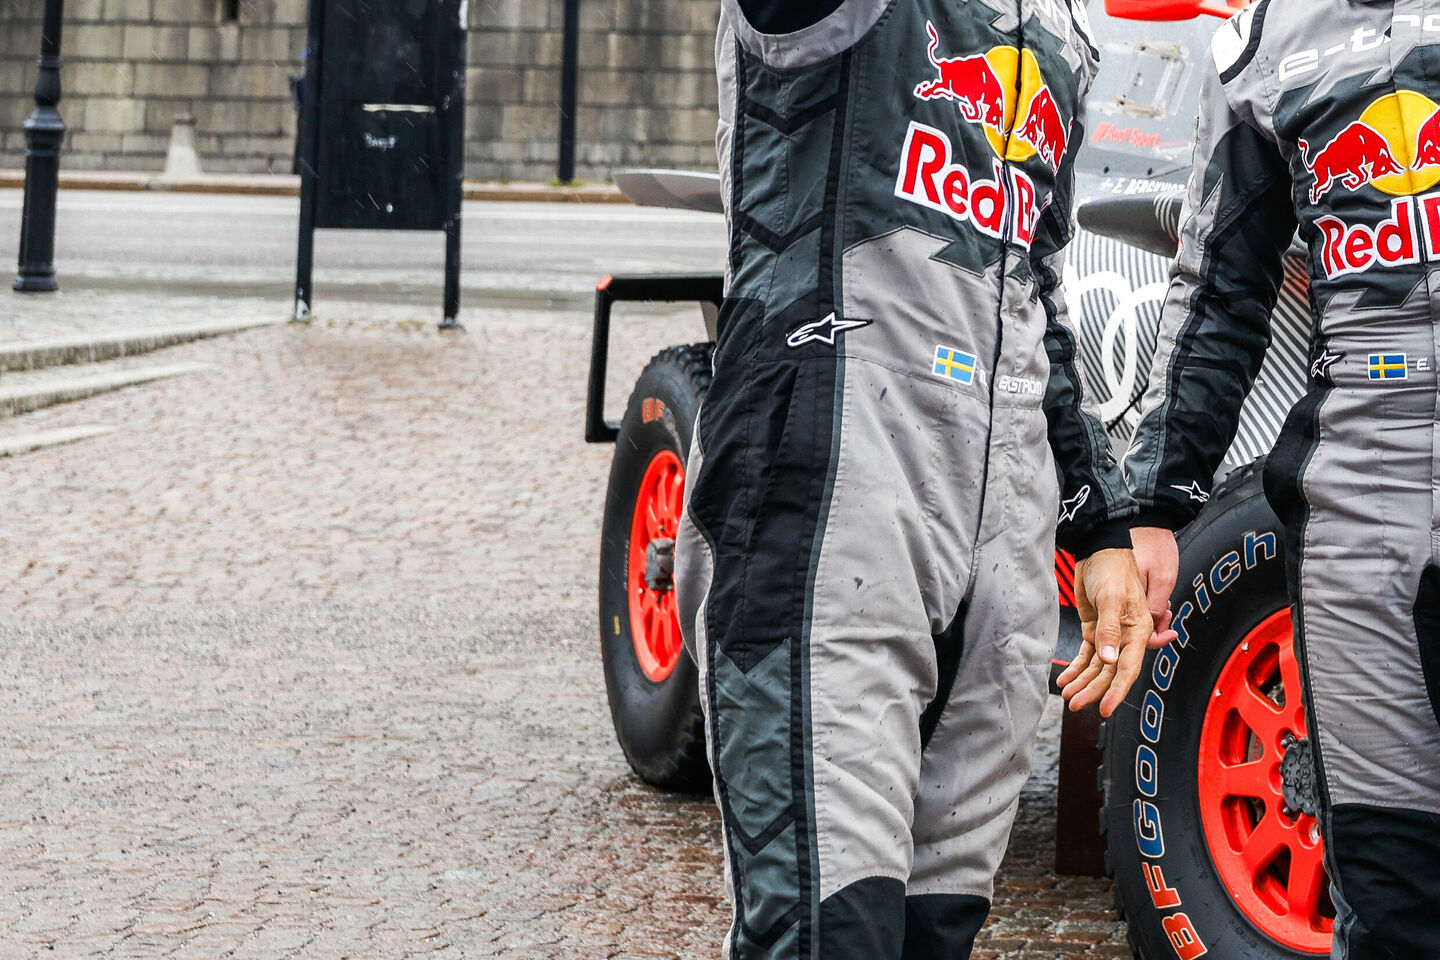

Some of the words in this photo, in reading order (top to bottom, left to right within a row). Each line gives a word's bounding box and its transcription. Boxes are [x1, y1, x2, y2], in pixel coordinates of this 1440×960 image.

[1106, 125, 1131, 142] Audi
[1129, 127, 1161, 147] Sport
[898, 123, 1005, 237] Red
[1315, 197, 1418, 278] Red
[998, 375, 1042, 395] EKSTRÖM
